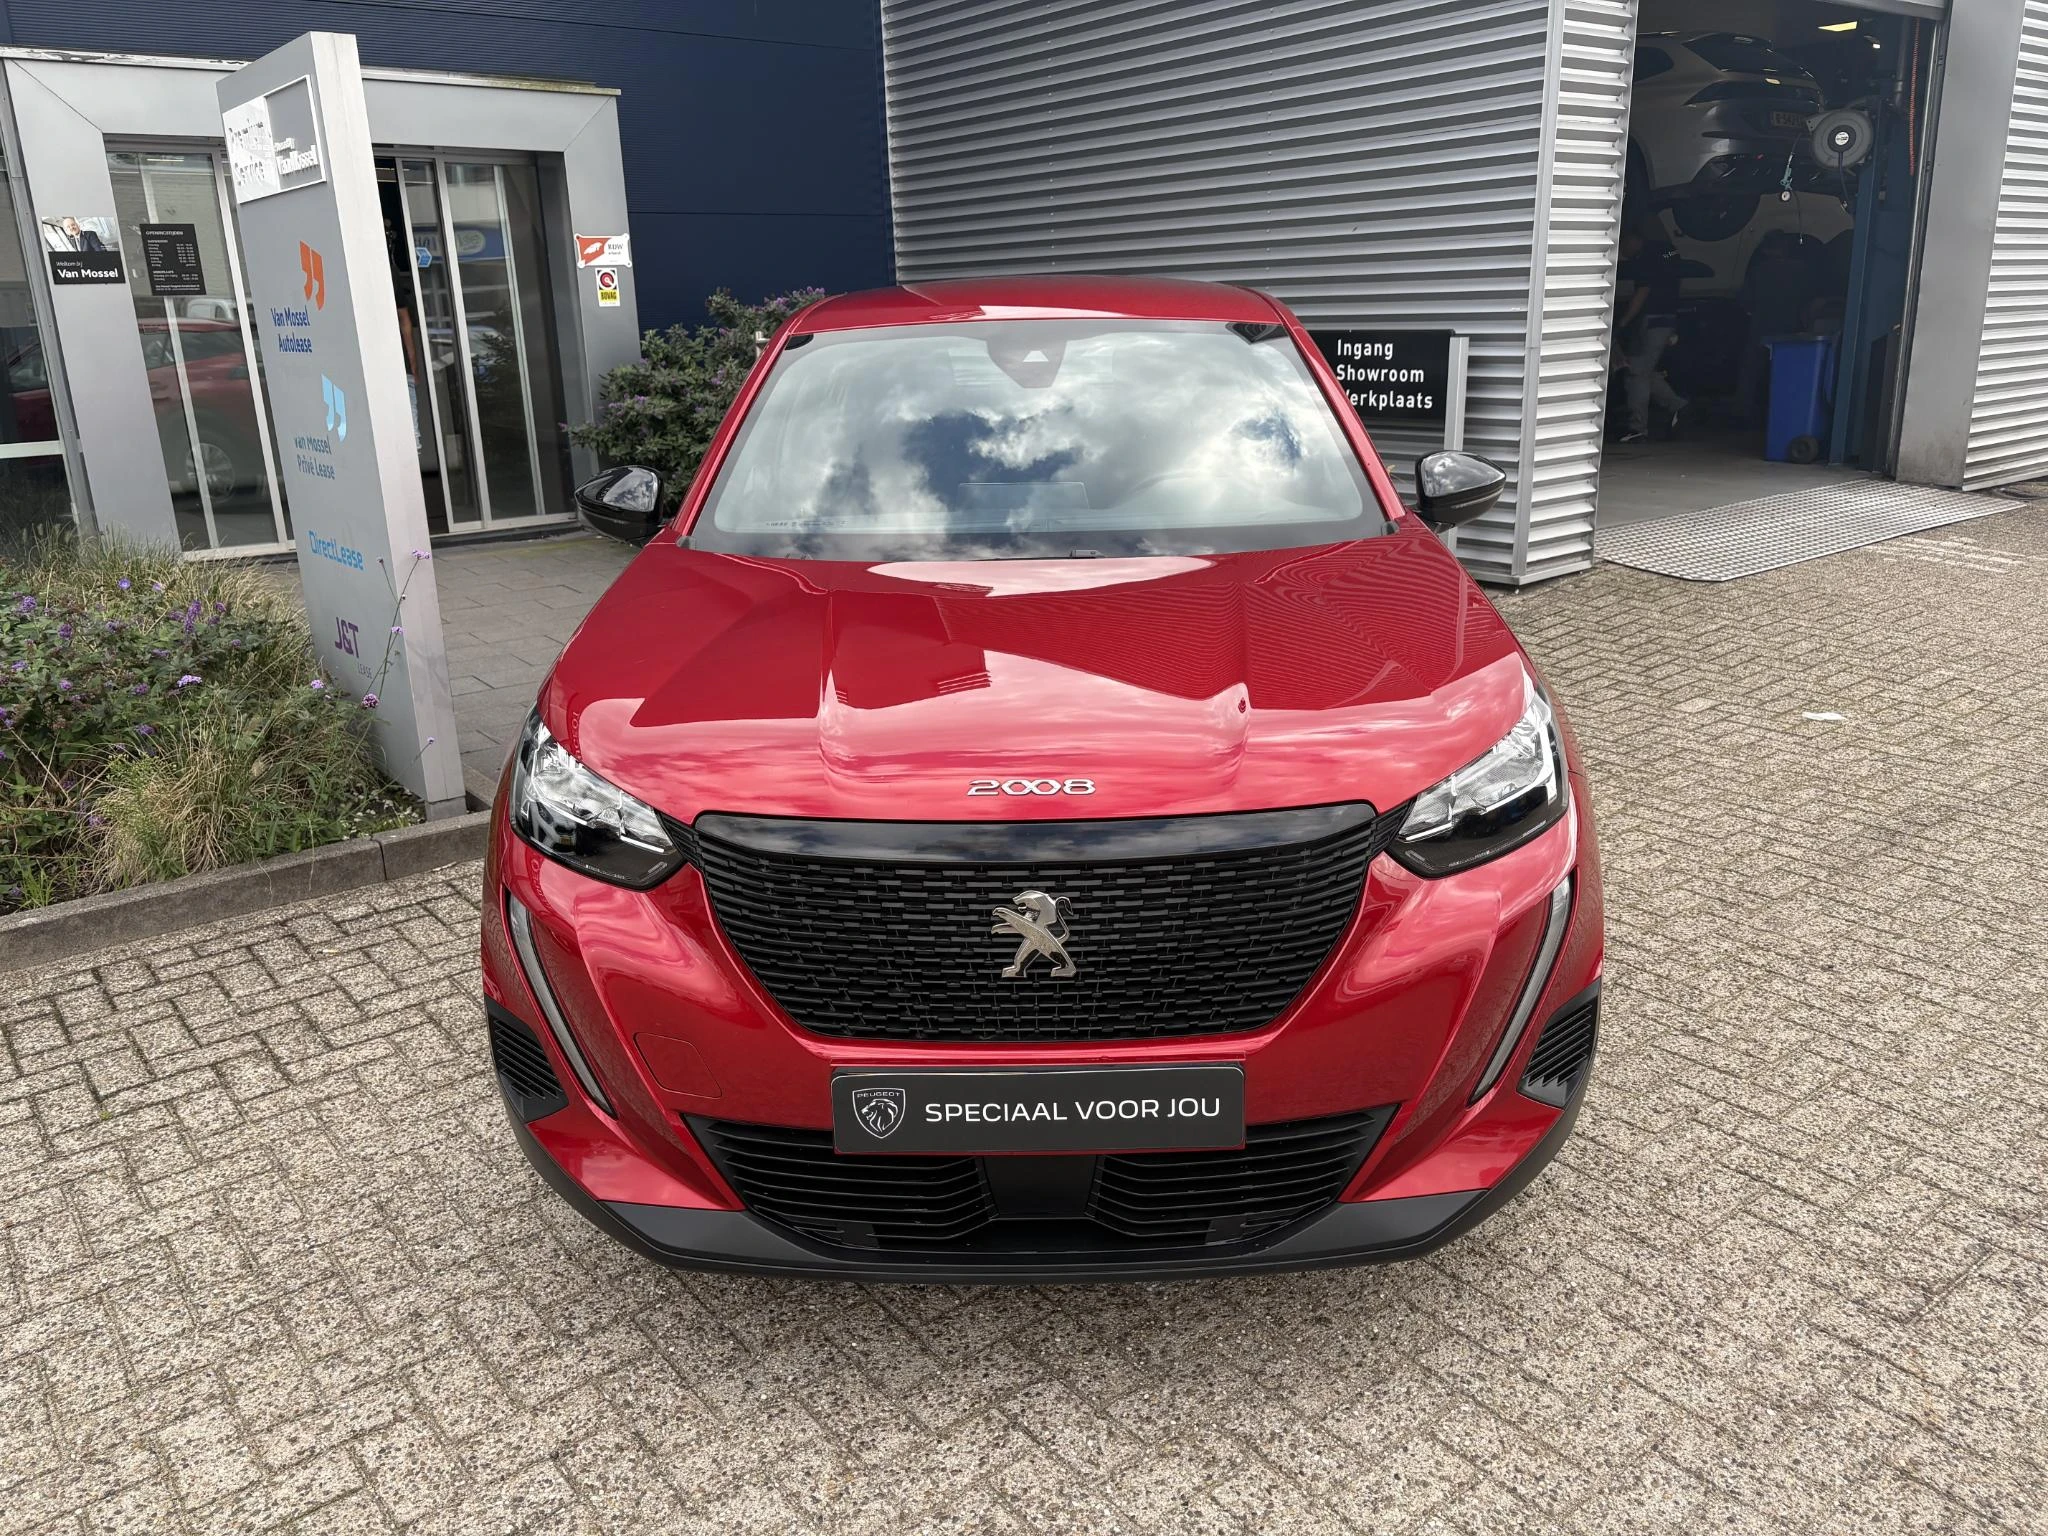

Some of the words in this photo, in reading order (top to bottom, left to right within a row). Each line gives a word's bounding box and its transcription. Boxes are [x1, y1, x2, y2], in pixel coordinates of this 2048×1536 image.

[57, 268, 79, 279] Van
[80, 267, 119, 279] Mossel
[270, 306, 285, 327] Van
[284, 304, 311, 327] Mossel
[277, 331, 313, 353] Autolease
[1337, 338, 1394, 360] Ingang
[1336, 363, 1425, 383] Showroom
[1345, 388, 1433, 411] erkplaats
[306, 434, 332, 455] Mossel
[314, 455, 336, 481] Lease
[308, 529, 364, 571] DirectLease
[967, 778, 1097, 796] 2008
[924, 1102, 1068, 1123] SPECIAAL
[1074, 1099, 1160, 1121] VOOR
[1167, 1097, 1220, 1118] JOU
